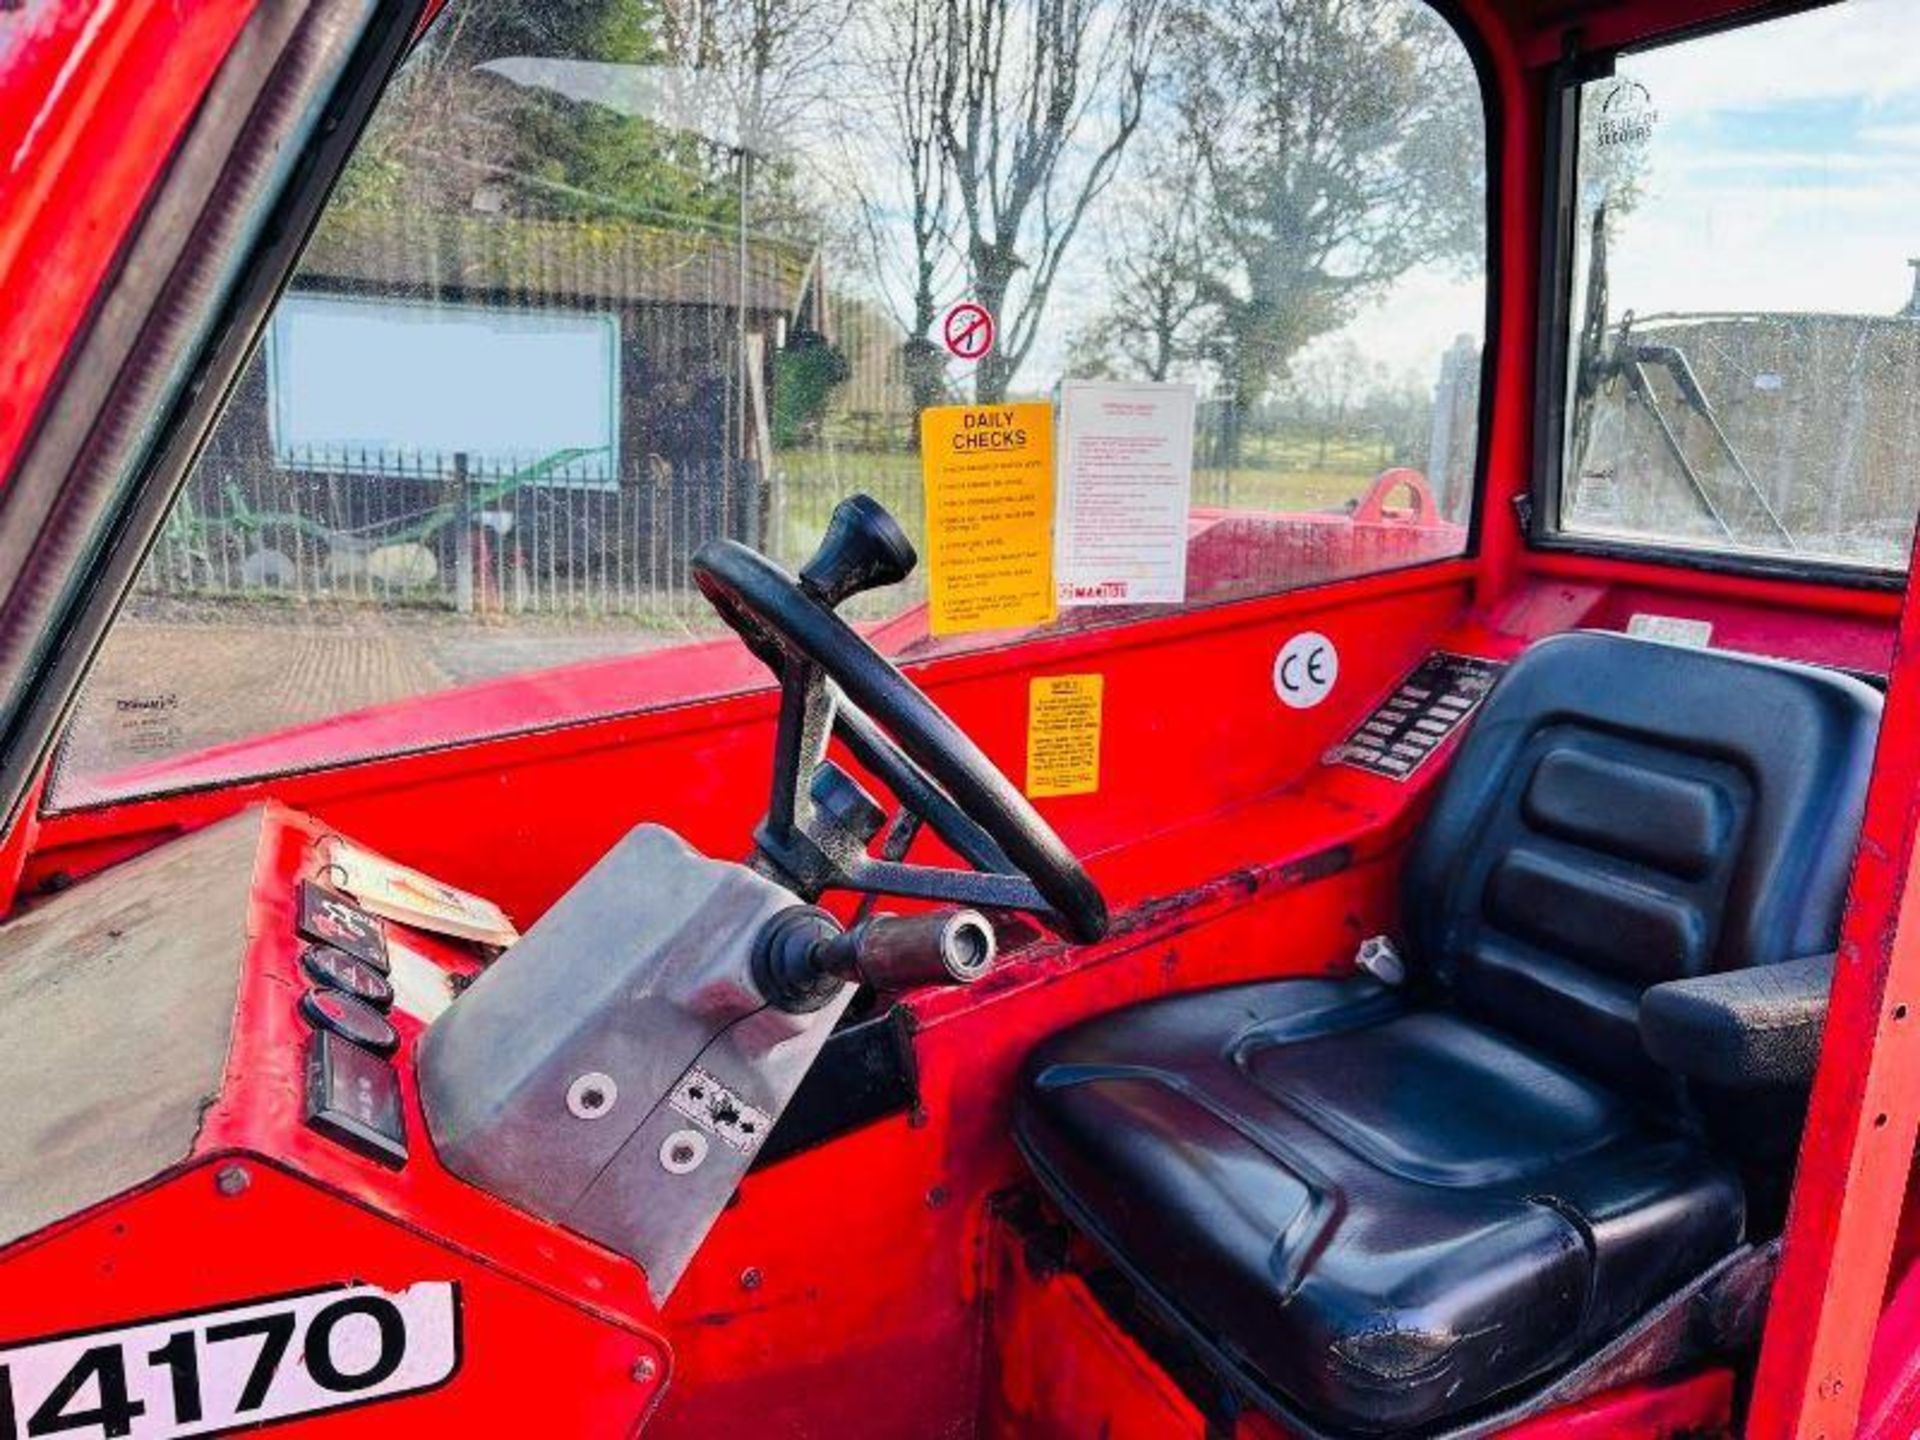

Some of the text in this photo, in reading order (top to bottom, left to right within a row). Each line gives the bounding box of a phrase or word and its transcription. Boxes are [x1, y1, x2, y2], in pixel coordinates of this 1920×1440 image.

[964, 411, 1014, 429] DAILY
[952, 429, 1027, 450] CHECKS
[0, 1296, 406, 1440] 4170
